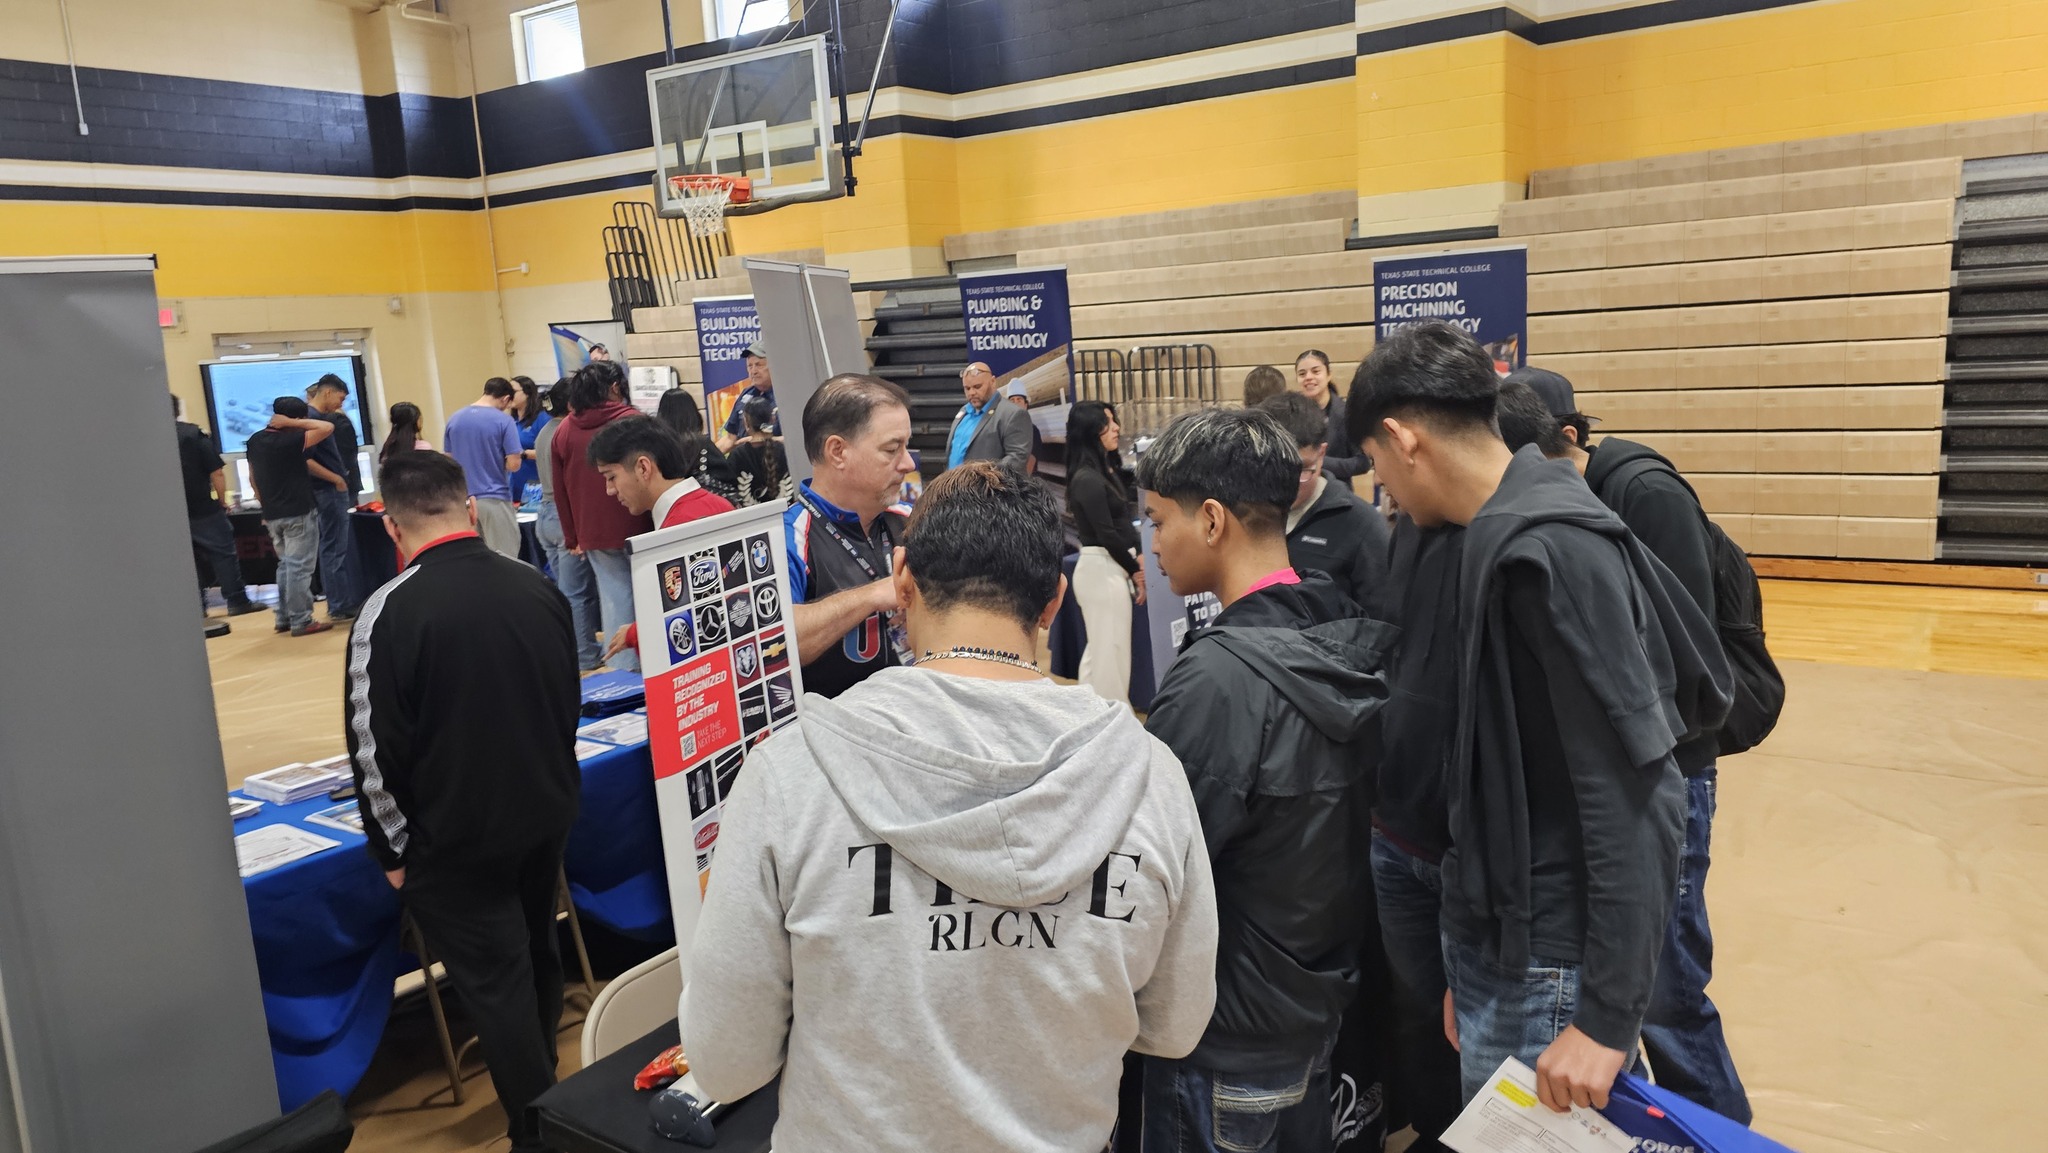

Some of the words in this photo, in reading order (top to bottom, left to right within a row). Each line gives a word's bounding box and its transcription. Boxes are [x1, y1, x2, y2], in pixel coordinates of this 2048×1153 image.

[1401, 270, 1420, 278] STATE
[1422, 267, 1458, 276] TECHNICAL
[1460, 264, 1491, 273] COLLEGE
[981, 286, 994, 294] STATE
[995, 285, 1021, 293] TECHNICAL
[1022, 283, 1044, 291] COLLEGE
[1381, 281, 1458, 301] PRECISION
[967, 296, 1028, 314] PLUMBING
[1030, 295, 1042, 310] &
[1381, 299, 1466, 319] MACHINING
[969, 314, 1036, 332] PIPEFITTING
[1380, 318, 1482, 338] TEOGY
[970, 332, 1048, 351] TECHNOLOGY
[692, 562, 717, 586] Ford
[1192, 606, 1208, 621] TO
[672, 662, 711, 690] TRAINING
[674, 670, 727, 704] RECOGNIZED
[676, 702, 689, 718] BY
[689, 694, 705, 713] THE
[678, 701, 719, 732] INDUSTRY
[696, 725, 709, 739] TAKE
[709, 720, 721, 734] THE
[698, 733, 713, 749] NEXT
[712, 727, 727, 744] STEP
[928, 910, 1061, 952] RLGN
